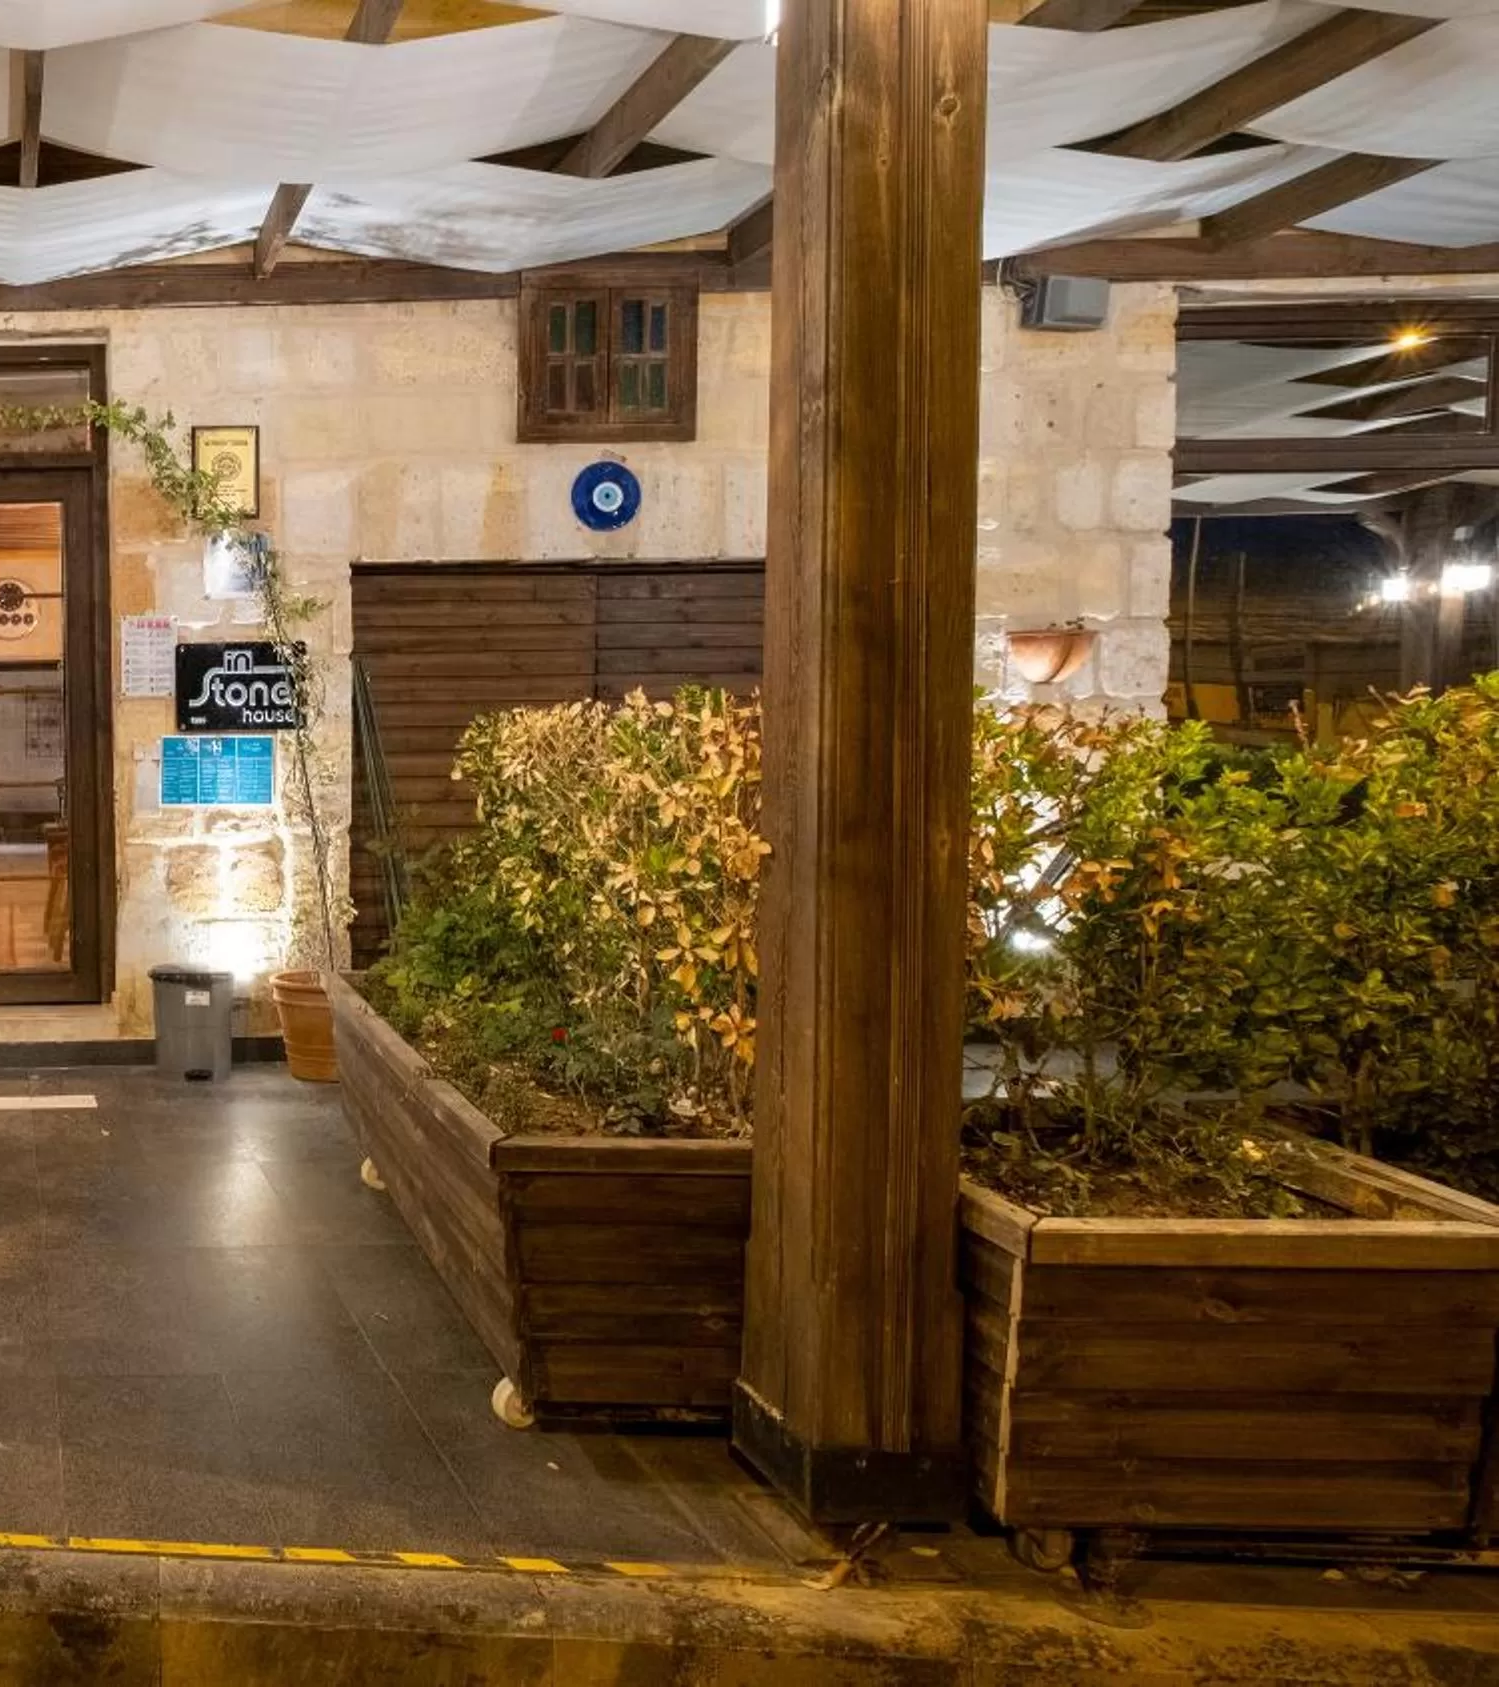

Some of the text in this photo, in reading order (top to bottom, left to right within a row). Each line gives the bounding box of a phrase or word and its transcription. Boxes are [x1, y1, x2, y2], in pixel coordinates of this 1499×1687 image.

[225, 651, 252, 673] in
[188, 667, 293, 707] Stone
[242, 708, 294, 723] house
